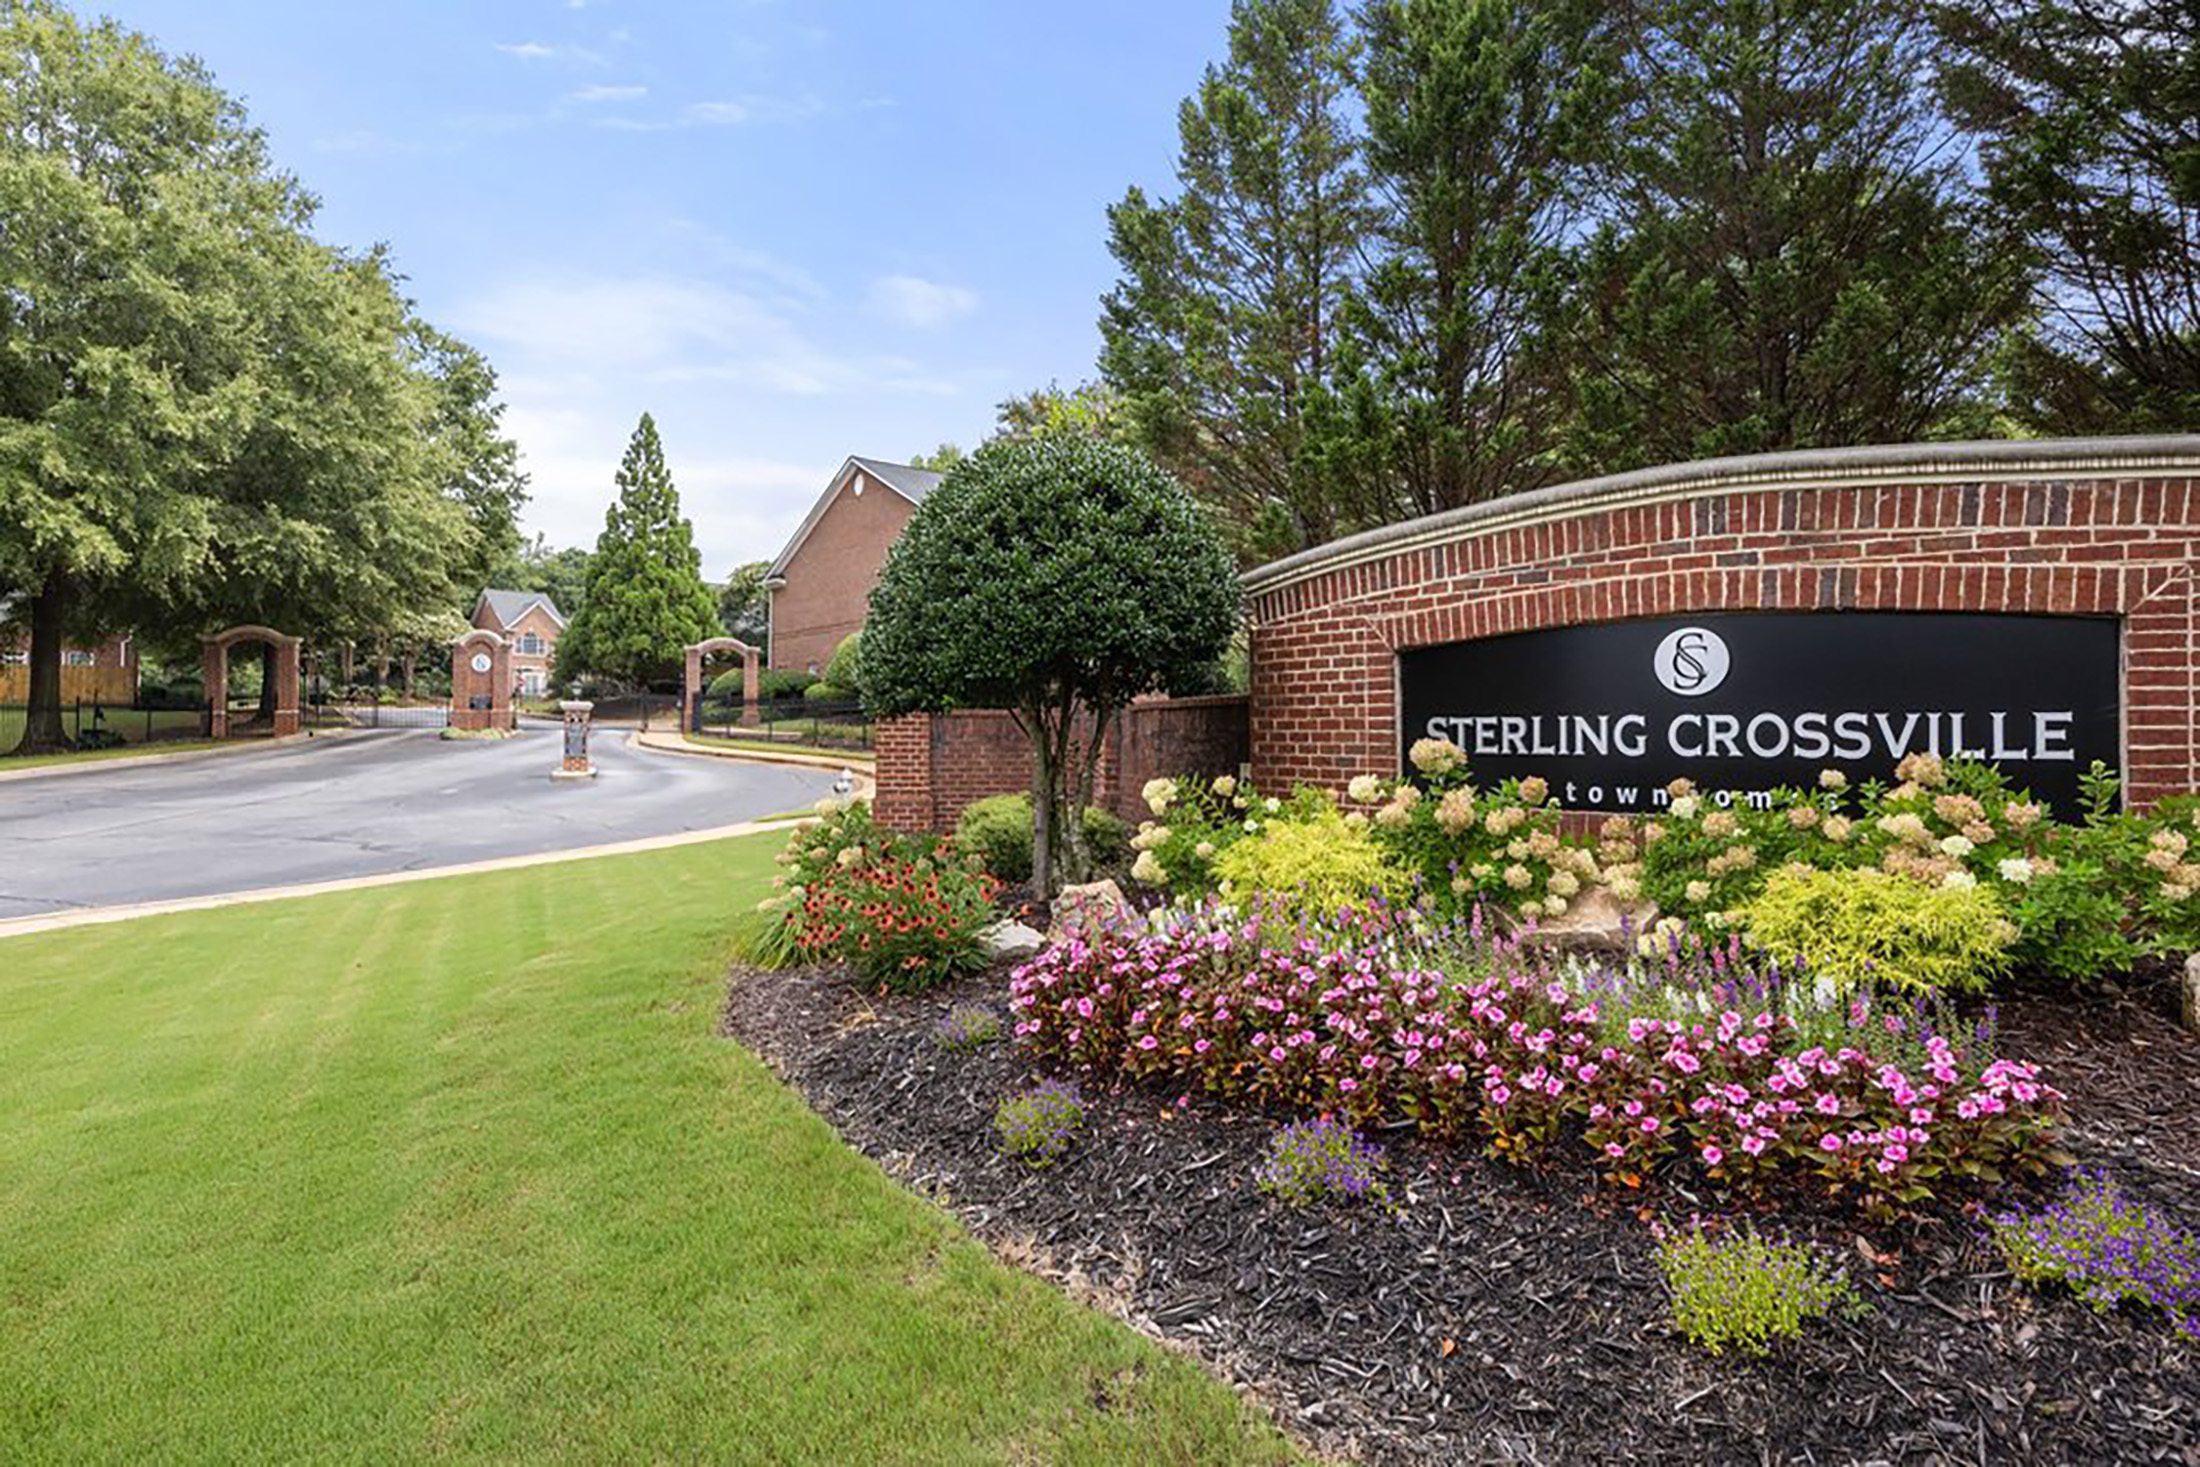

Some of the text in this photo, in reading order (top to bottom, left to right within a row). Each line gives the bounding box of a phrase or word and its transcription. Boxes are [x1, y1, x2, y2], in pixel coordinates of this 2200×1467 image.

[1426, 711, 2076, 761] STERLING CROSSVILLE
[1565, 781, 1839, 812] townoms
